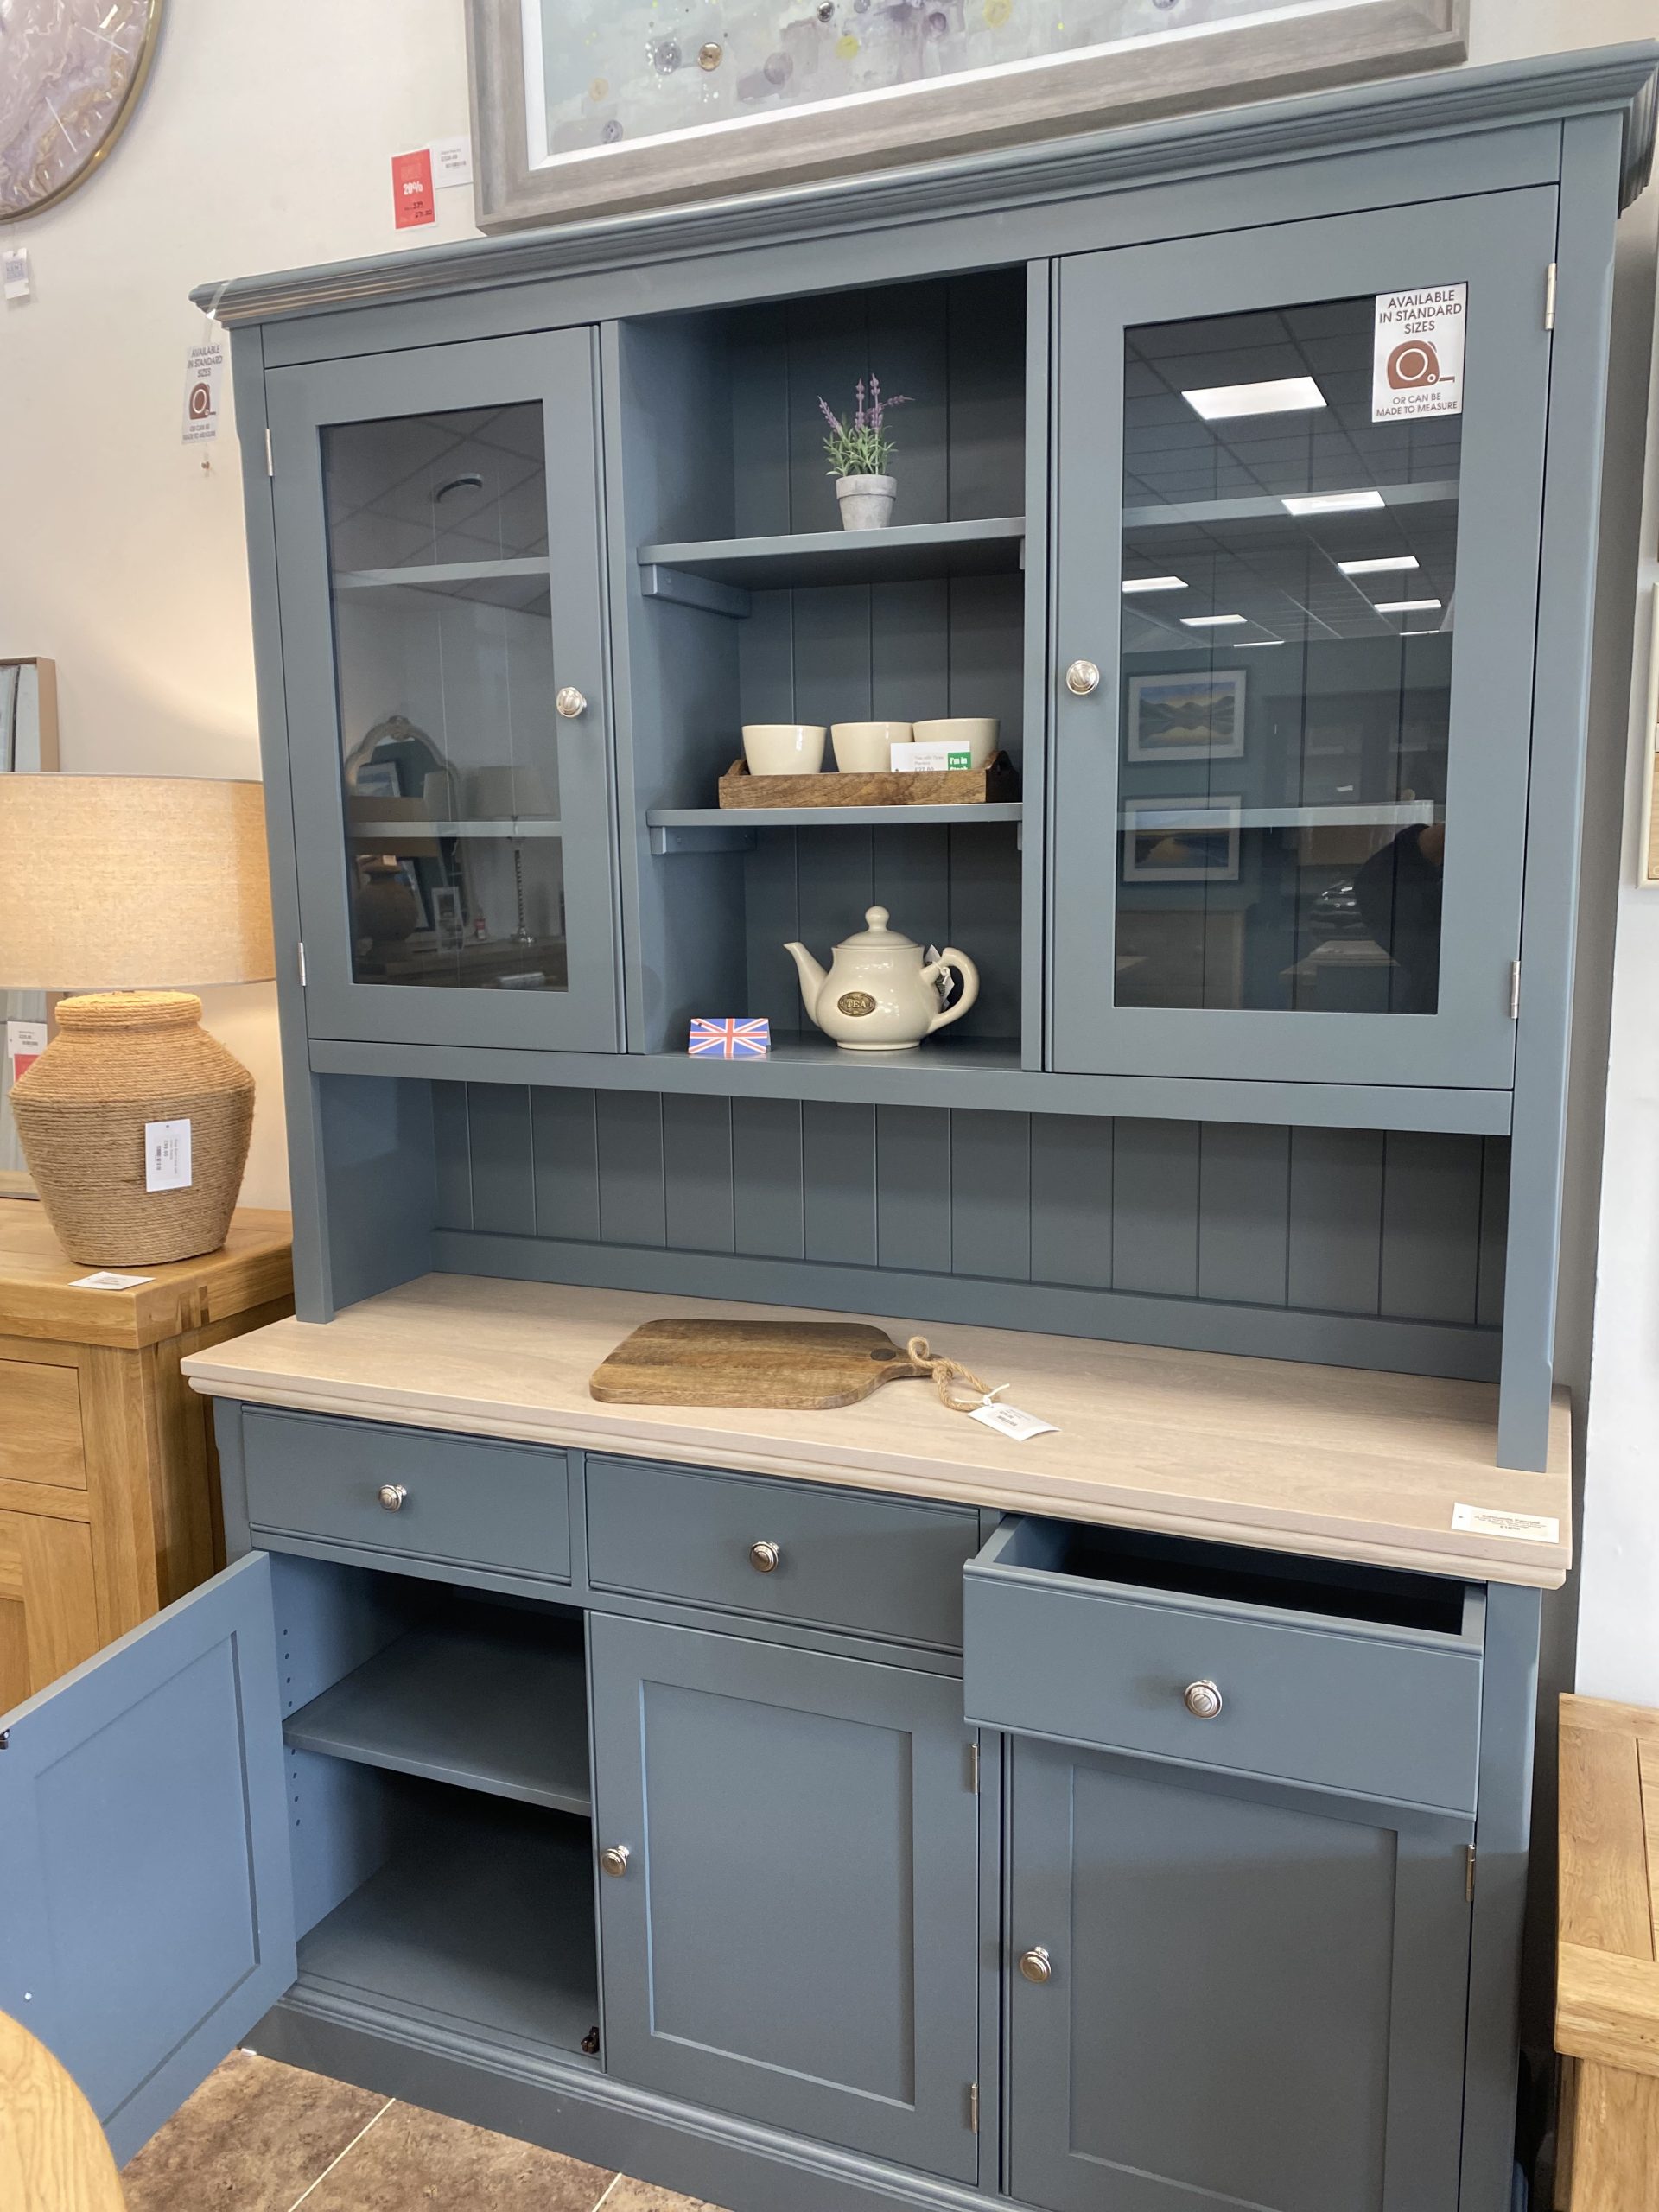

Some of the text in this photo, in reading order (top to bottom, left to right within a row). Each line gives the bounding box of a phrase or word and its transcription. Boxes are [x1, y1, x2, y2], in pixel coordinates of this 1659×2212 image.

[403, 181, 423, 195] 20%
[1388, 290, 1455, 309] AVAILABLE
[1380, 303, 1462, 323] IN STANDARD
[1404, 321, 1435, 334] SIZES
[192, 345, 220, 358] AVAILABLE
[188, 355, 223, 369] IN STANDARD
[197, 367, 212, 378] SIZES
[1393, 392, 1441, 405] OR CAN BE
[1376, 400, 1458, 416] MADE TO MEASURE
[846, 999, 866, 1007] TEA
